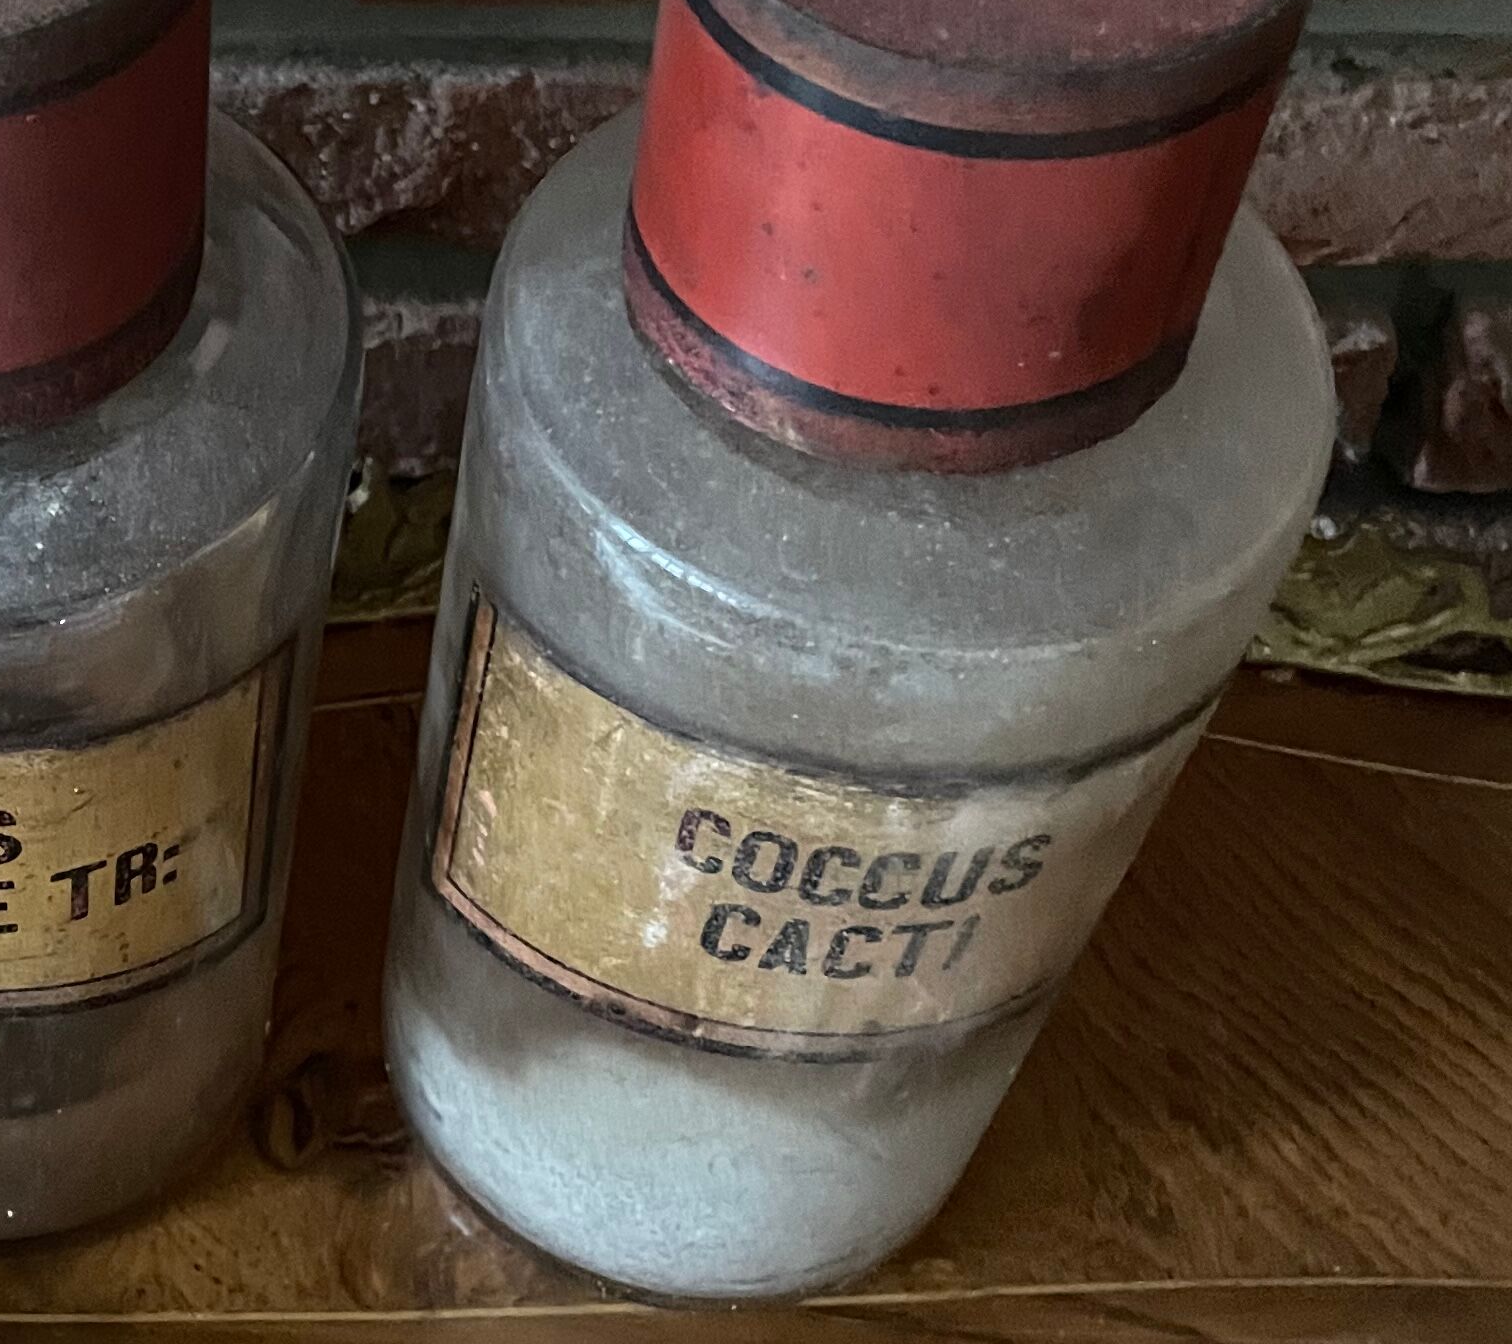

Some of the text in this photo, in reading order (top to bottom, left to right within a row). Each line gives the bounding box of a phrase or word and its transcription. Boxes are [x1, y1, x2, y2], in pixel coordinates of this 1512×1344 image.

[49, 842, 181, 921] TR:
[675, 808, 1052, 911] COCCUS
[699, 902, 981, 981] CACTI
